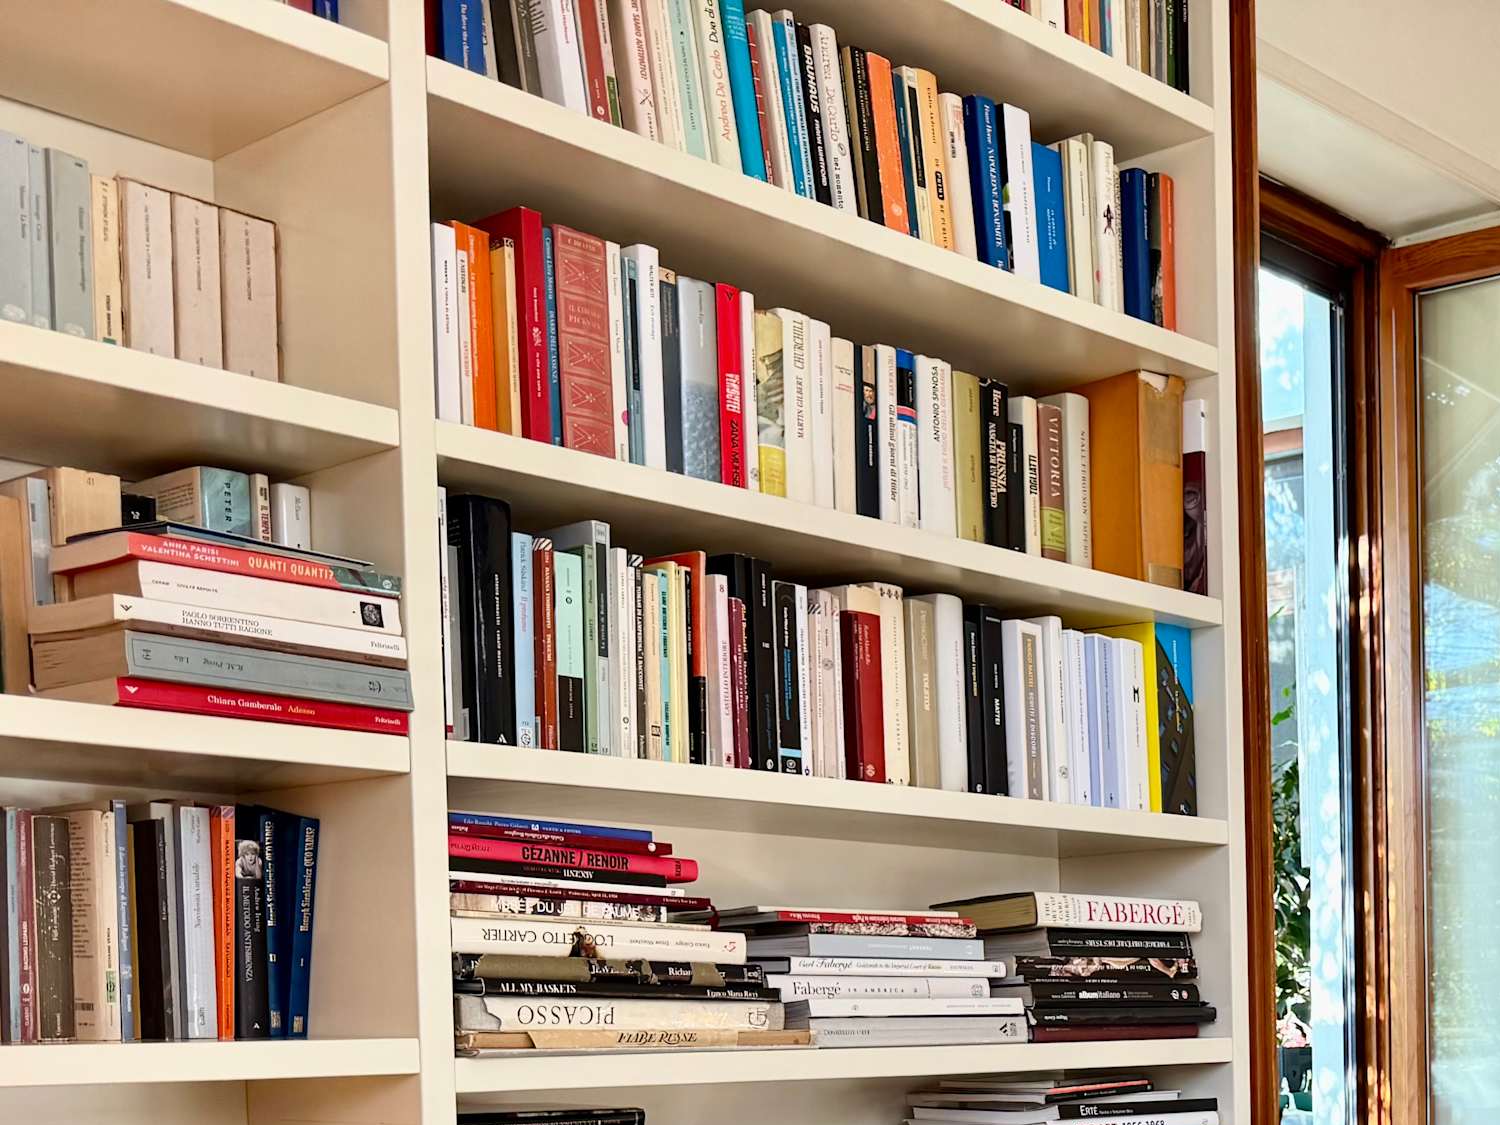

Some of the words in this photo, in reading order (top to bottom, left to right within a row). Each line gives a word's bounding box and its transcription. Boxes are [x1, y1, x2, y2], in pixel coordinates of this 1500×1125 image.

[630, 12, 645, 37] SIAMO
[708, 20, 719, 44] Due
[633, 37, 651, 80] ANTIPATICI?
[711, 49, 724, 80] Carlo
[716, 82, 726, 100] De
[803, 44, 820, 114] BAUHAUS
[718, 101, 732, 142] Andrea
[813, 119, 824, 144] FRANK
[817, 145, 828, 187] WHITFORD
[988, 147, 999, 198] NAPOLEONE
[835, 172, 844, 209] momento
[935, 172, 944, 199] PRIMA
[992, 198, 1003, 248] BONAPARTE
[547, 310, 557, 335] DIARIO
[793, 319, 804, 370] CHURCHILL
[549, 335, 559, 384] DELL'ASSENZA
[796, 375, 805, 409] GILBERT
[992, 388, 1002, 417] Herre
[887, 403, 896, 414] Gli
[730, 420, 739, 447] ZANA
[797, 411, 805, 439] MARTIN
[888, 416, 897, 441] ultimi
[988, 421, 998, 455] NASCITA
[1078, 429, 1087, 460] NIALL
[888, 442, 897, 467] giorni
[988, 454, 998, 465] DI
[996, 439, 1007, 494] PRUSSIA
[1048, 417, 1061, 498] VITTORIA
[86, 476, 95, 486] 41
[989, 465, 998, 477] UN
[1028, 454, 1038, 496] TOGLIATTI
[889, 478, 898, 503] Hitler
[989, 476, 999, 509] IMPERO
[1079, 463, 1088, 515] FERGUSON
[223, 481, 233, 523] PETER
[261, 513, 269, 535] TEMPO
[162, 541, 188, 550] ANNA
[190, 545, 220, 555] PARISI
[519, 541, 527, 564] Patrick
[1081, 520, 1090, 560] IMPERO
[140, 544, 192, 559] VALENTINA
[193, 553, 240, 567] SCHETTINI
[248, 557, 288, 572] QUANTI
[290, 562, 335, 581] QUANTI?
[635, 585, 643, 608] TOMASI
[181, 609, 207, 620] PAOLO
[208, 613, 260, 627] SORRENTINO
[181, 617, 212, 628] HANNO
[214, 620, 237, 631] TUTTI
[238, 624, 273, 636] RAGIONE
[636, 615, 644, 652] LAMPEDUSA
[637, 659, 645, 690] RACCONTI
[207, 695, 236, 707] Chiara
[238, 698, 282, 712] Gamberale
[287, 704, 316, 716] Adesso
[721, 678, 730, 716] CASTELLO
[264, 821, 273, 846] VADIS?
[304, 827, 315, 852] VADIS?
[266, 846, 274, 861] QUO
[303, 851, 312, 867] QUO
[521, 845, 577, 866] CÉZANNE
[587, 853, 629, 871] RENOIR
[242, 886, 249, 894] IL
[301, 868, 312, 908] Sienkiewicz
[121, 901, 130, 928] Raymond
[243, 895, 251, 929] METODO
[267, 902, 277, 927] Henryk
[300, 908, 309, 932] Henryk
[537, 901, 554, 914] DU
[1087, 900, 1186, 926] FABERGÉ
[482, 928, 537, 944] CARTIER
[245, 930, 253, 982] ANTISBRONZA
[798, 959, 814, 969] Carl
[815, 957, 853, 974] Fabergé
[500, 983, 519, 993] ALL
[519, 983, 534, 993] MY
[536, 983, 577, 994] BASKETS
[793, 979, 841, 999] Fabergé
[517, 1005, 615, 1025] PICASSO
[617, 1032, 657, 1046] FIABE
[658, 1032, 698, 1046] RUSSE
[1080, 1104, 1098, 1116] ERTÉ
